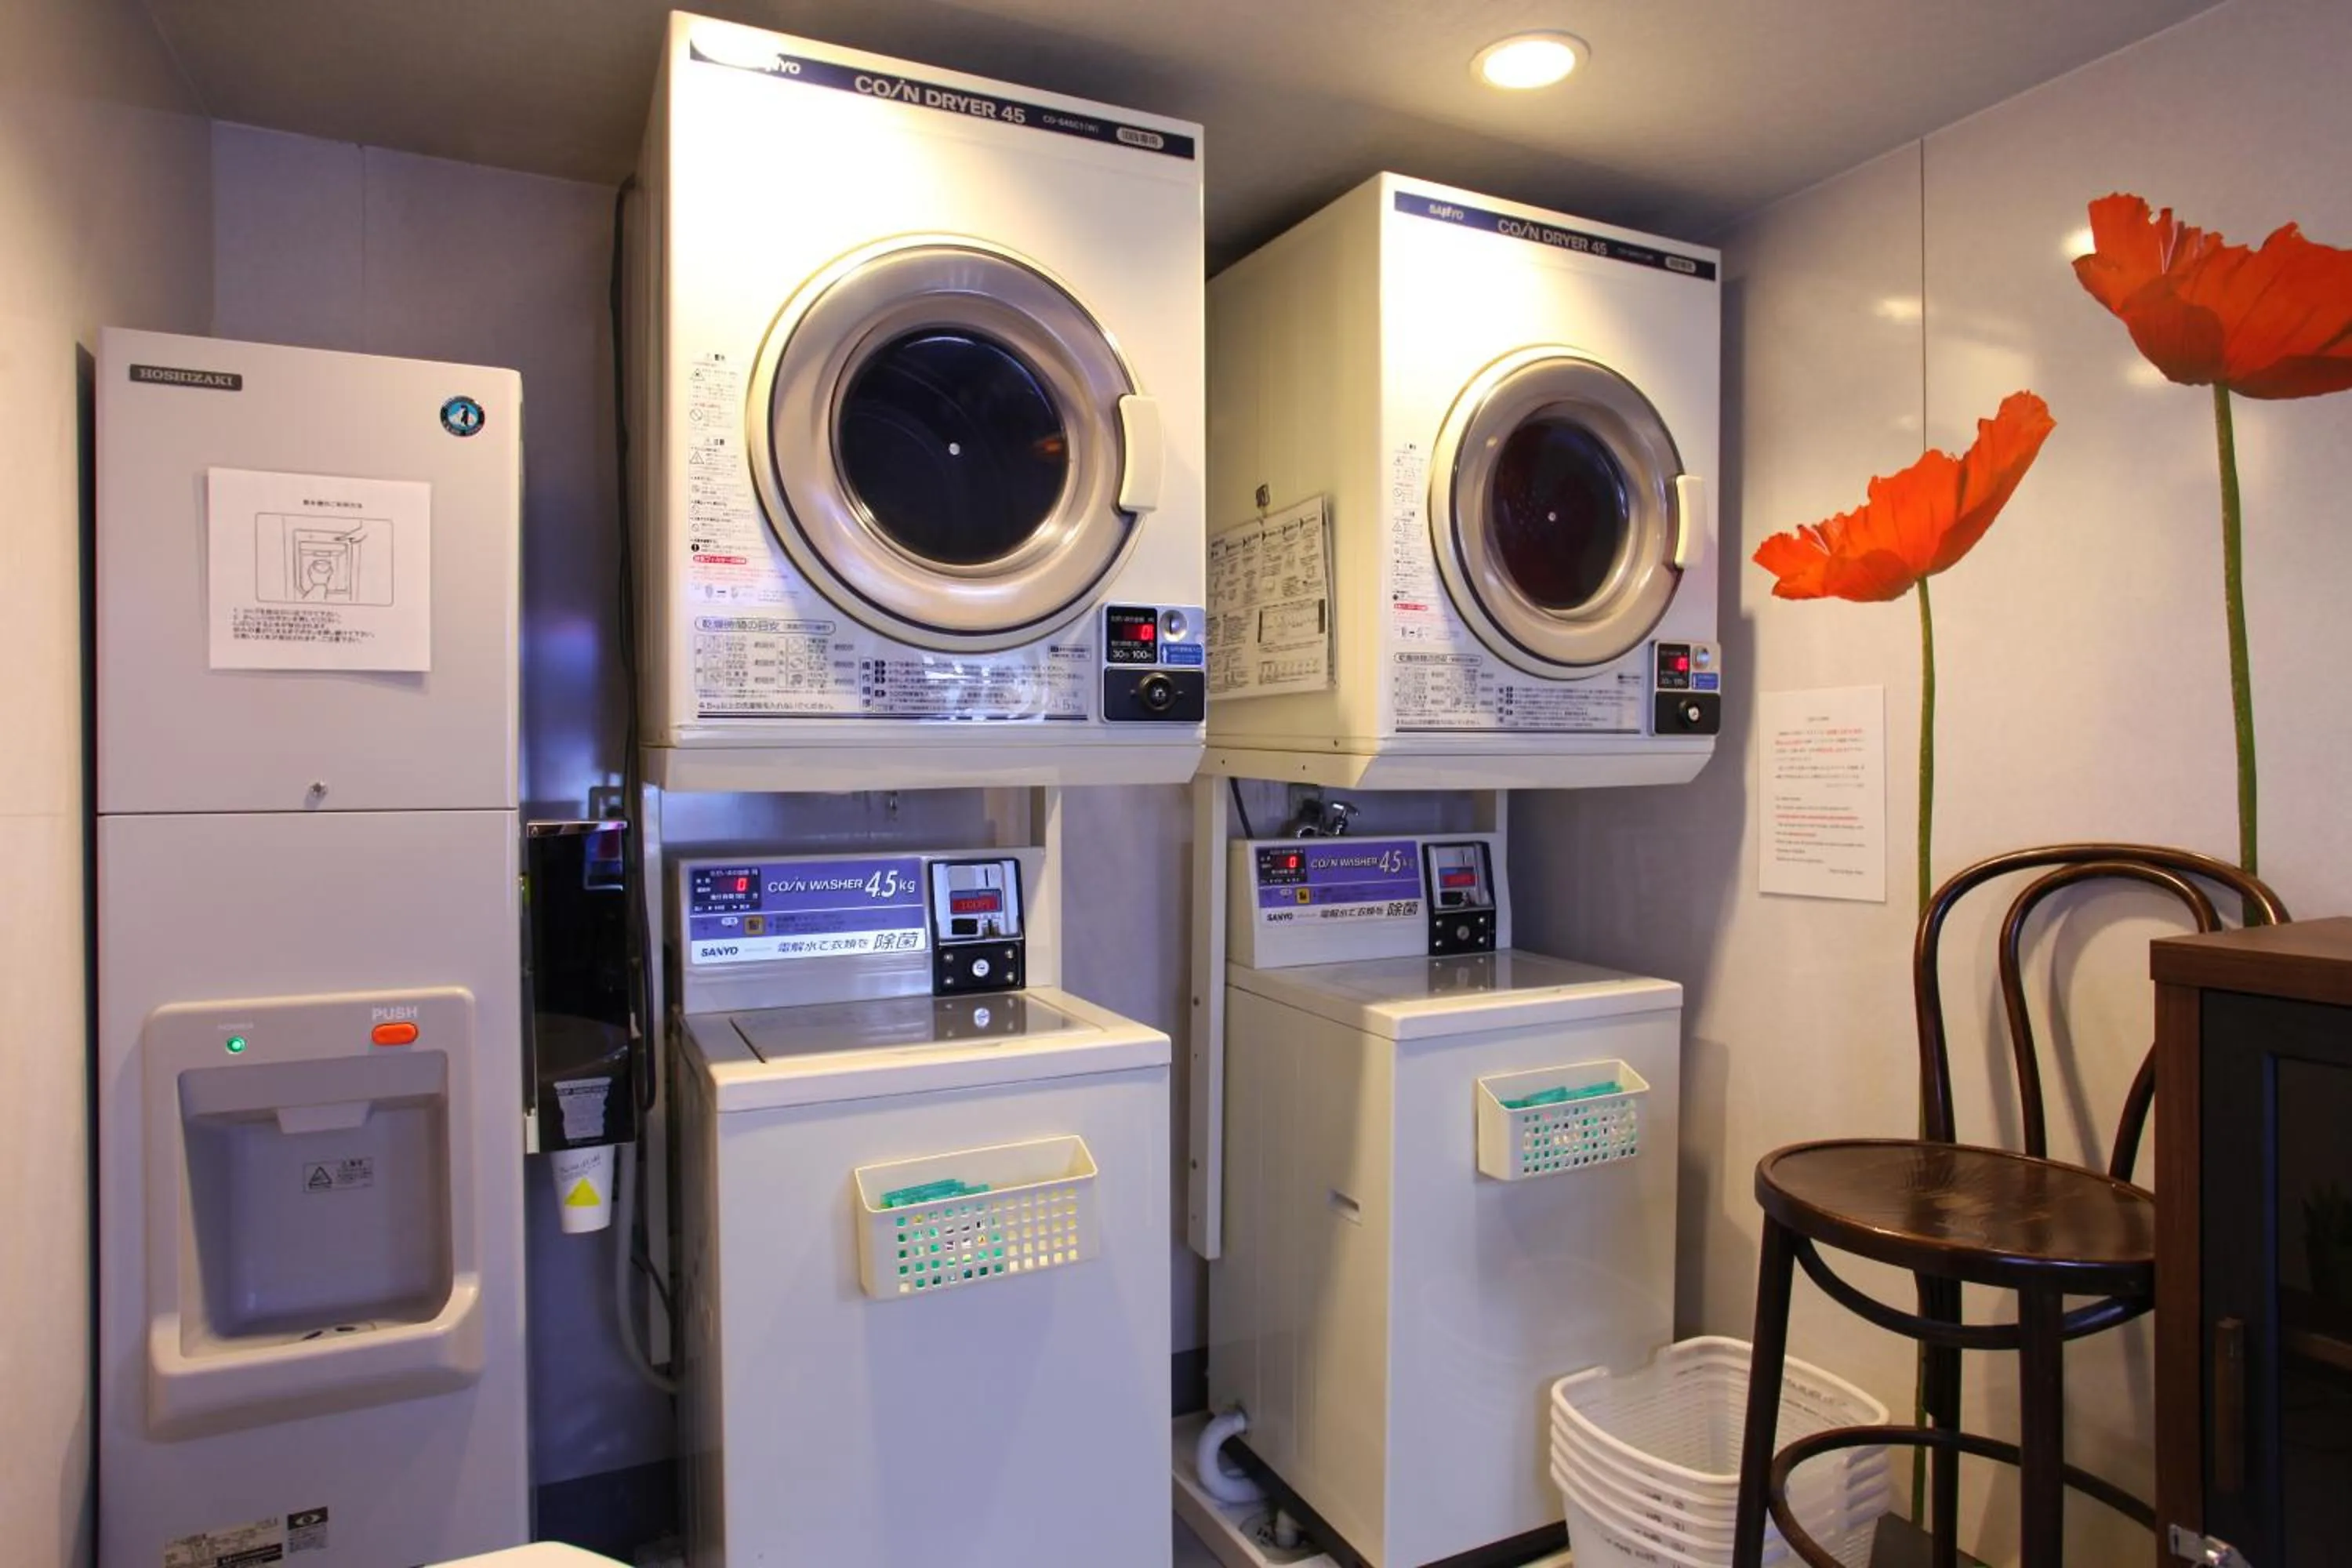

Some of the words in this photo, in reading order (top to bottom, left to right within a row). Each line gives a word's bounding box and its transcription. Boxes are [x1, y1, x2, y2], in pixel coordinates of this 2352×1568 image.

[925, 89, 996, 118] DRYER
[1000, 106, 1025, 124] 45
[1543, 228, 1588, 252] DRYER
[1591, 240, 1607, 256] 45
[139, 368, 234, 386] HOSHIZAKI
[738, 877, 747, 891] 0
[810, 879, 863, 891] WASHER
[701, 946, 739, 957] SANYO
[372, 1006, 417, 1021] PUSH
